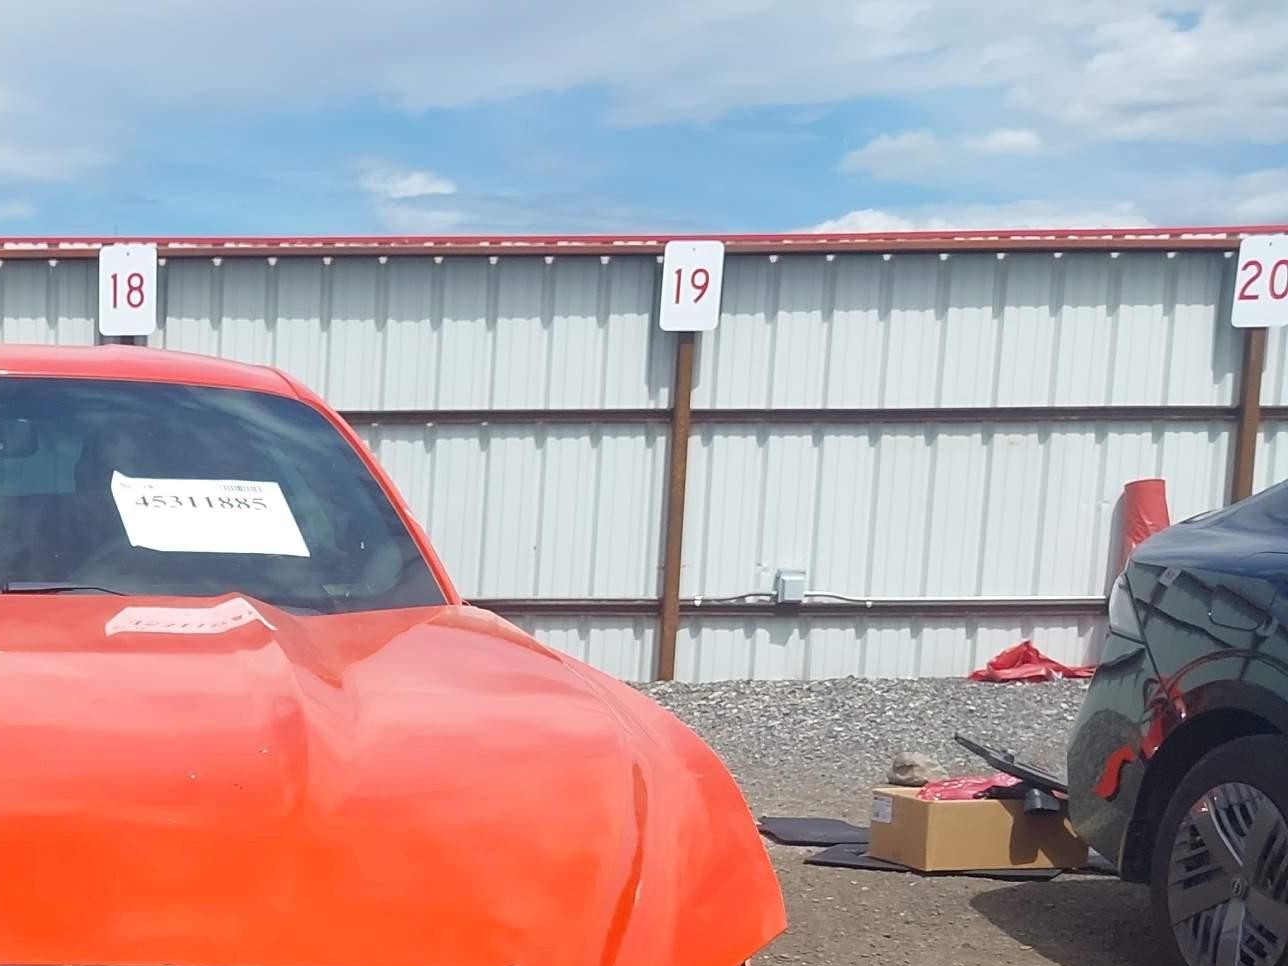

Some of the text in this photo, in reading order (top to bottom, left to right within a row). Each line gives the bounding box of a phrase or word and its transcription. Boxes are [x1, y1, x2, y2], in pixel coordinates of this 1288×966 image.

[110, 272, 144, 309] 18
[674, 268, 709, 304] 19
[1238, 259, 1288, 300] 20
[135, 495, 268, 511] 45311885
